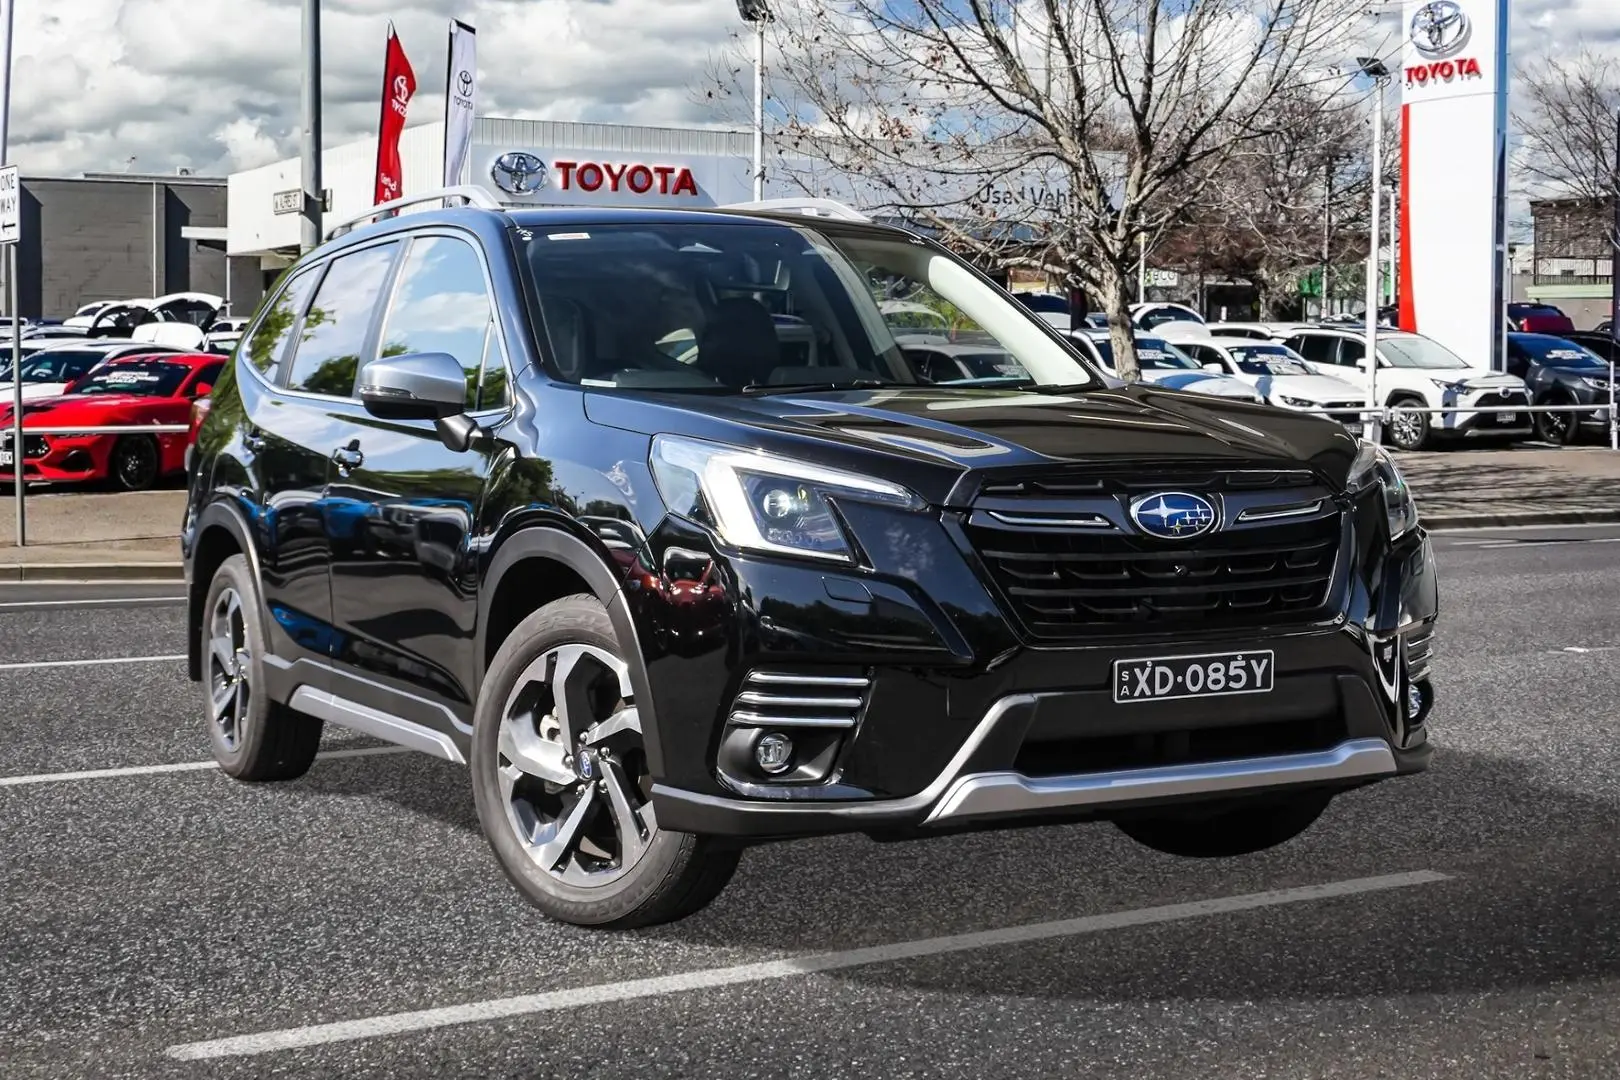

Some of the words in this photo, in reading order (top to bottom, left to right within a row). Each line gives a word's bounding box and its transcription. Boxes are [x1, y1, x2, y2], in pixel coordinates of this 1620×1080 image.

[1405, 59, 1481, 84] TOYOTA
[0, 173, 15, 191] ONE
[555, 161, 698, 196] TOYOTA
[1, 196, 16, 213] WAY
